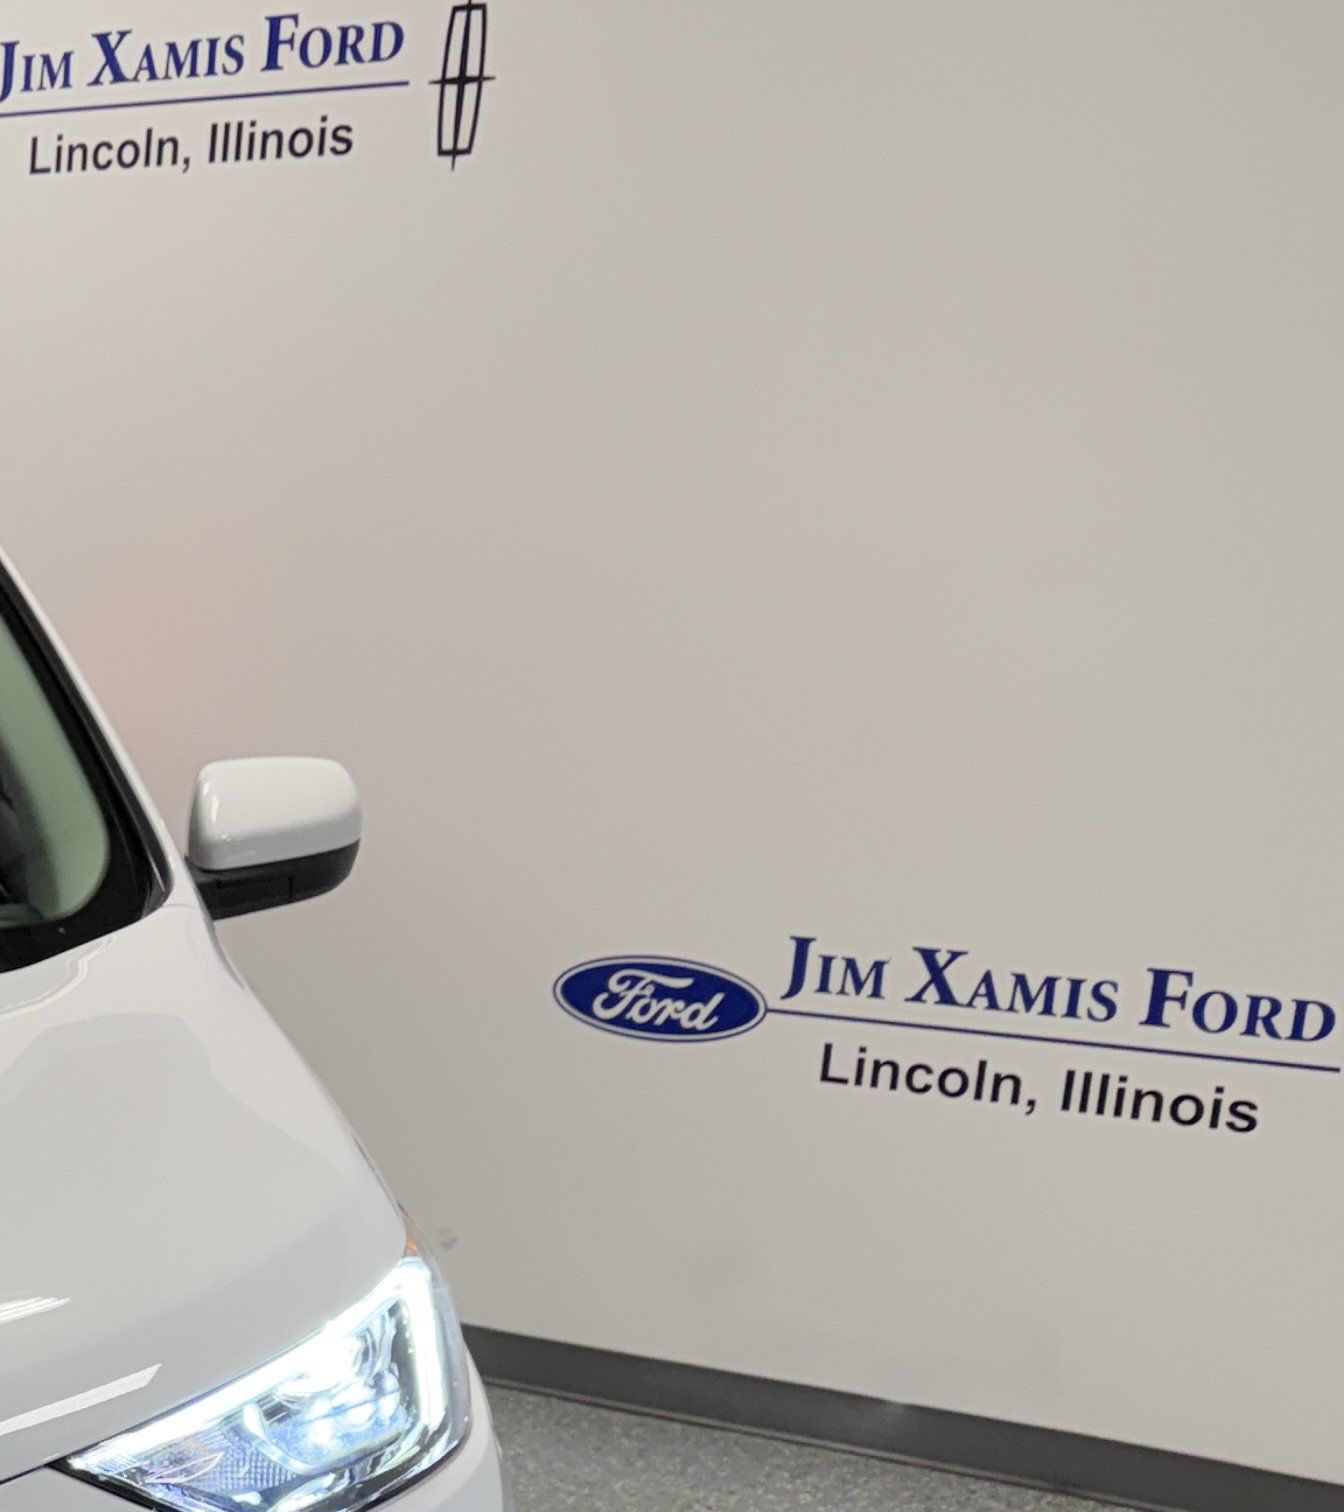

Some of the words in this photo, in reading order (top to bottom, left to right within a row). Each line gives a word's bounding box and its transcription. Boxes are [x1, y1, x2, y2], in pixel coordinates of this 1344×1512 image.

[90, 30, 245, 87] XAMIS
[260, 13, 405, 72] FORD
[29, 127, 191, 174] Lincoln,
[209, 115, 354, 164] Illinois
[594, 967, 724, 1031] Ford
[781, 936, 887, 1001] JIM
[911, 946, 1117, 1024] XAMIS
[1139, 966, 1337, 1045] FORD
[819, 1043, 1038, 1114] Lincoln,
[1060, 1069, 1259, 1134] Illinois
